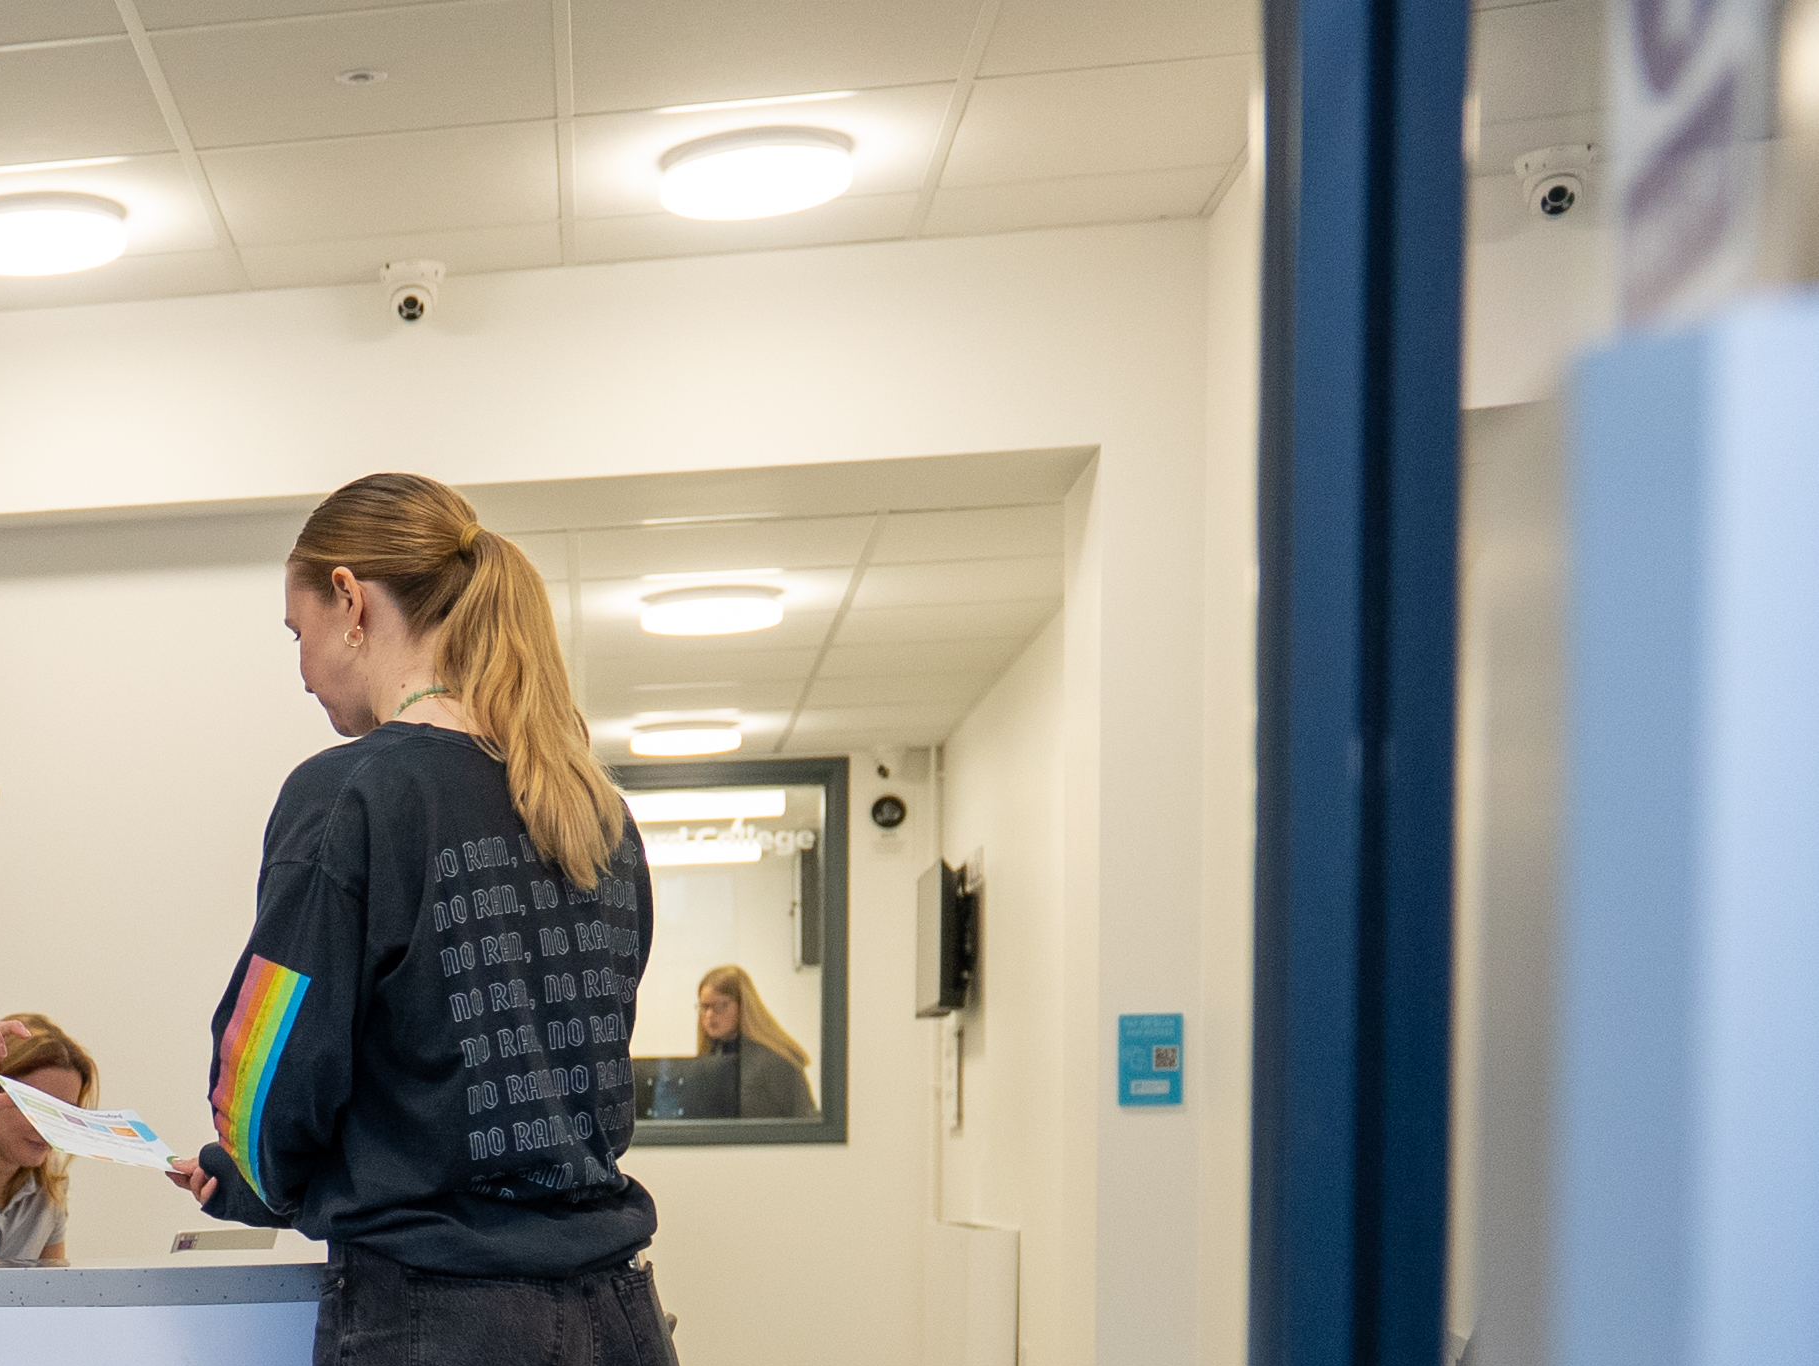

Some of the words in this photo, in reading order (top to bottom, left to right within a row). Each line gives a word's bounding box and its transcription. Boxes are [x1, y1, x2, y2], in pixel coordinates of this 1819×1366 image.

[694, 826, 816, 856] College
[433, 895, 468, 932] NO
[530, 880, 559, 909] NO
[440, 942, 476, 977] NO
[538, 926, 570, 957] NO
[449, 988, 484, 1022] NO
[543, 973, 577, 1004] NO
[461, 1034, 490, 1068] NO
[547, 1018, 585, 1050] NO
[467, 1080, 499, 1115] NO
[552, 1064, 589, 1094] NO
[469, 1126, 507, 1160] NO
